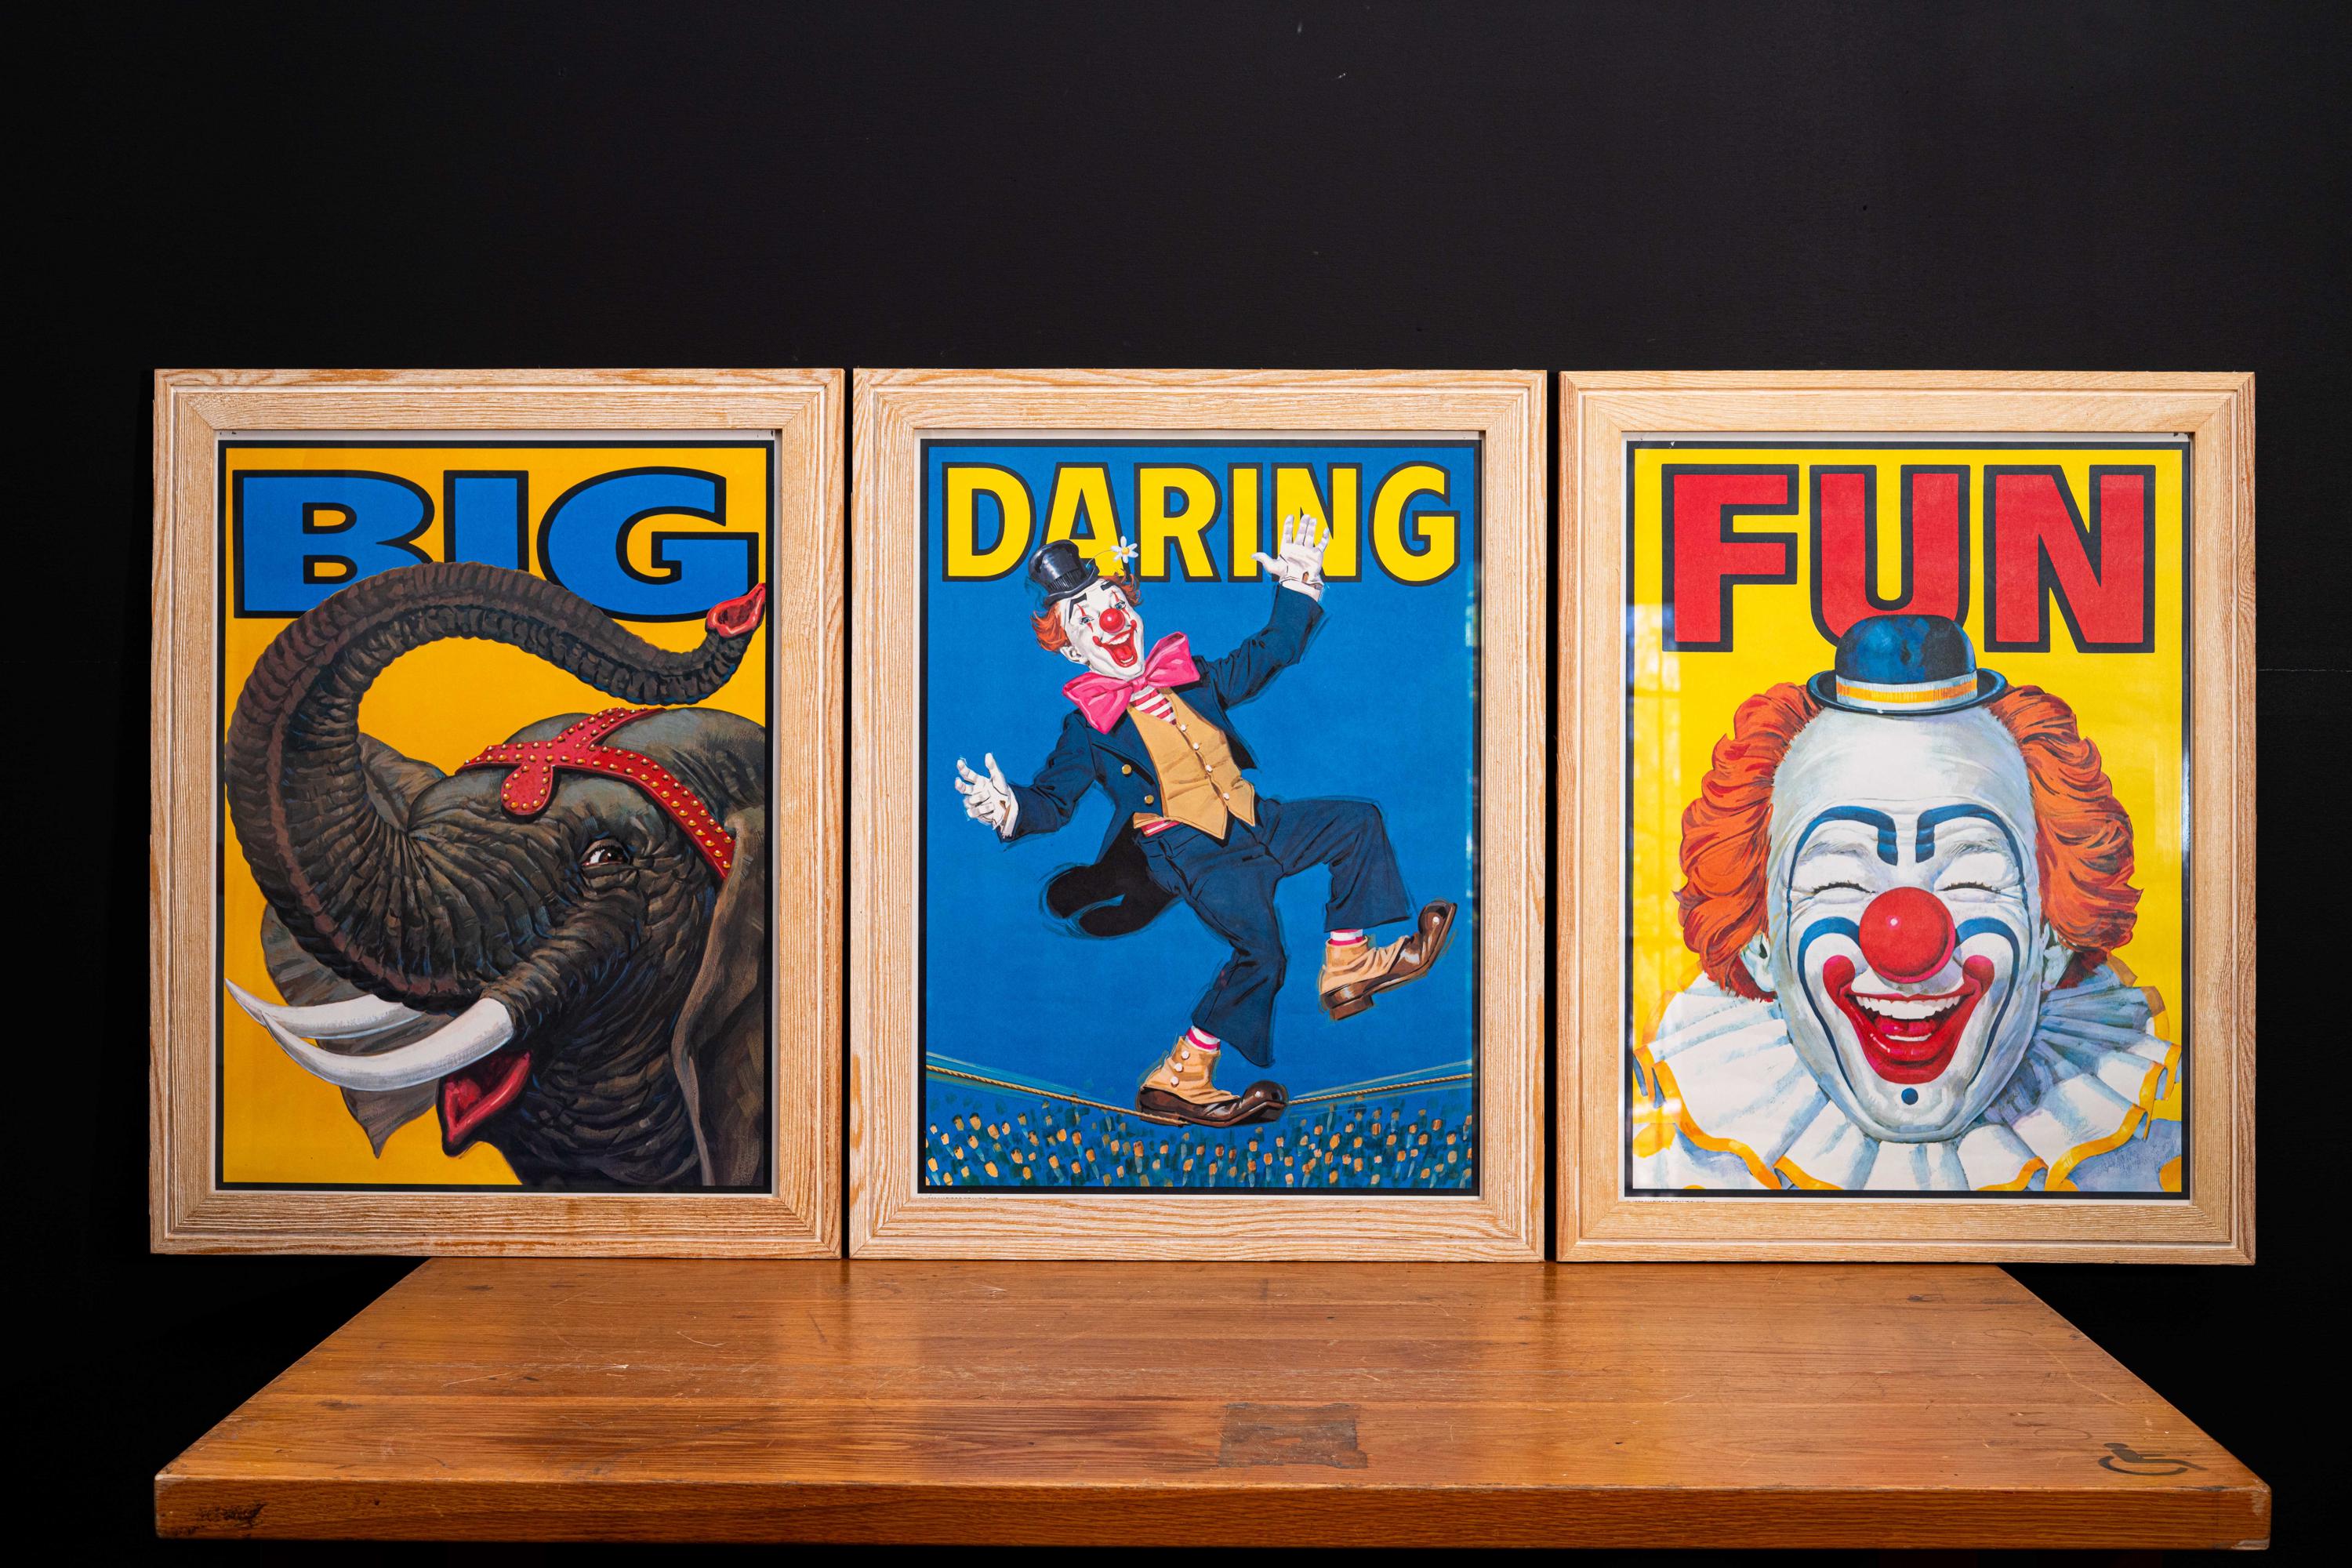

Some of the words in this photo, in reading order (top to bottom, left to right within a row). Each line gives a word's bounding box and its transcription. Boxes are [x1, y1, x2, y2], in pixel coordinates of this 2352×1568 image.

[233, 466, 759, 622] BIG
[942, 461, 1460, 586] DARING
[1661, 463, 2155, 653] FUN
